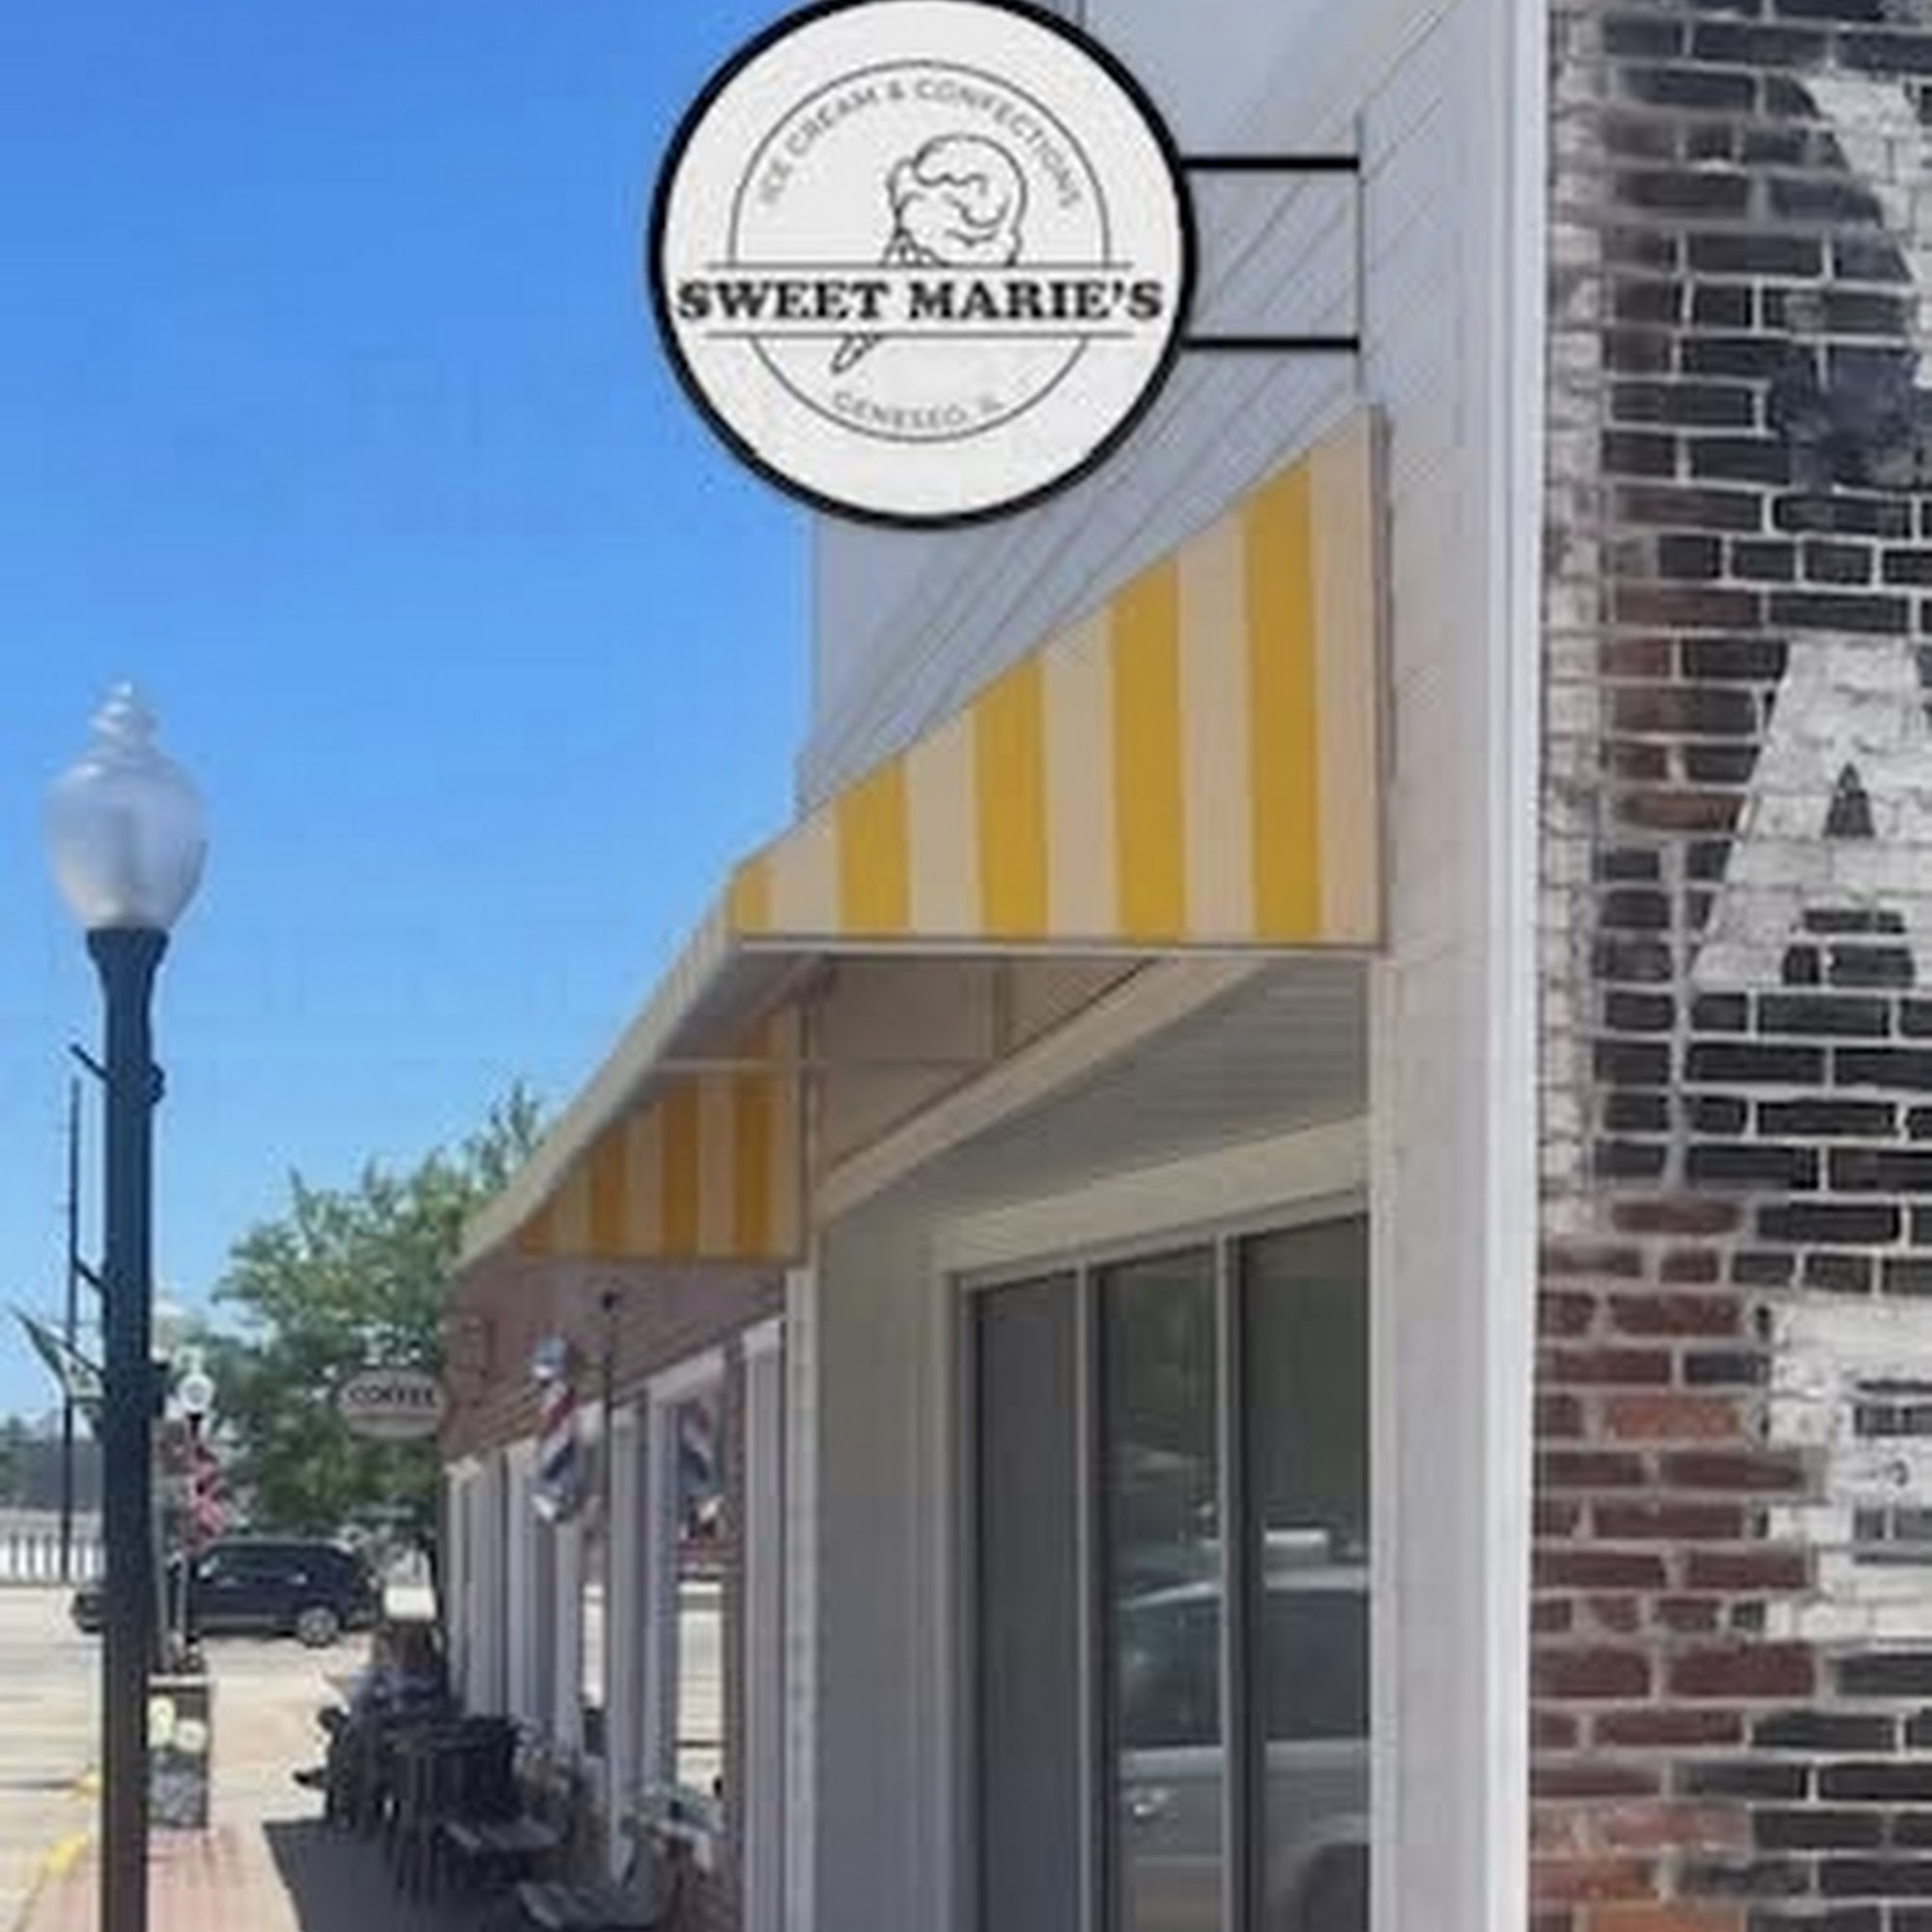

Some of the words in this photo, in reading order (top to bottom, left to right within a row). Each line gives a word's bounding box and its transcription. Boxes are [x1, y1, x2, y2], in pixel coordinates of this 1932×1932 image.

[784, 85, 880, 157] CREAM
[915, 78, 1082, 210] CONFECTIONS
[678, 279, 891, 321] SWEET
[908, 279, 1164, 321] MARIE'S
